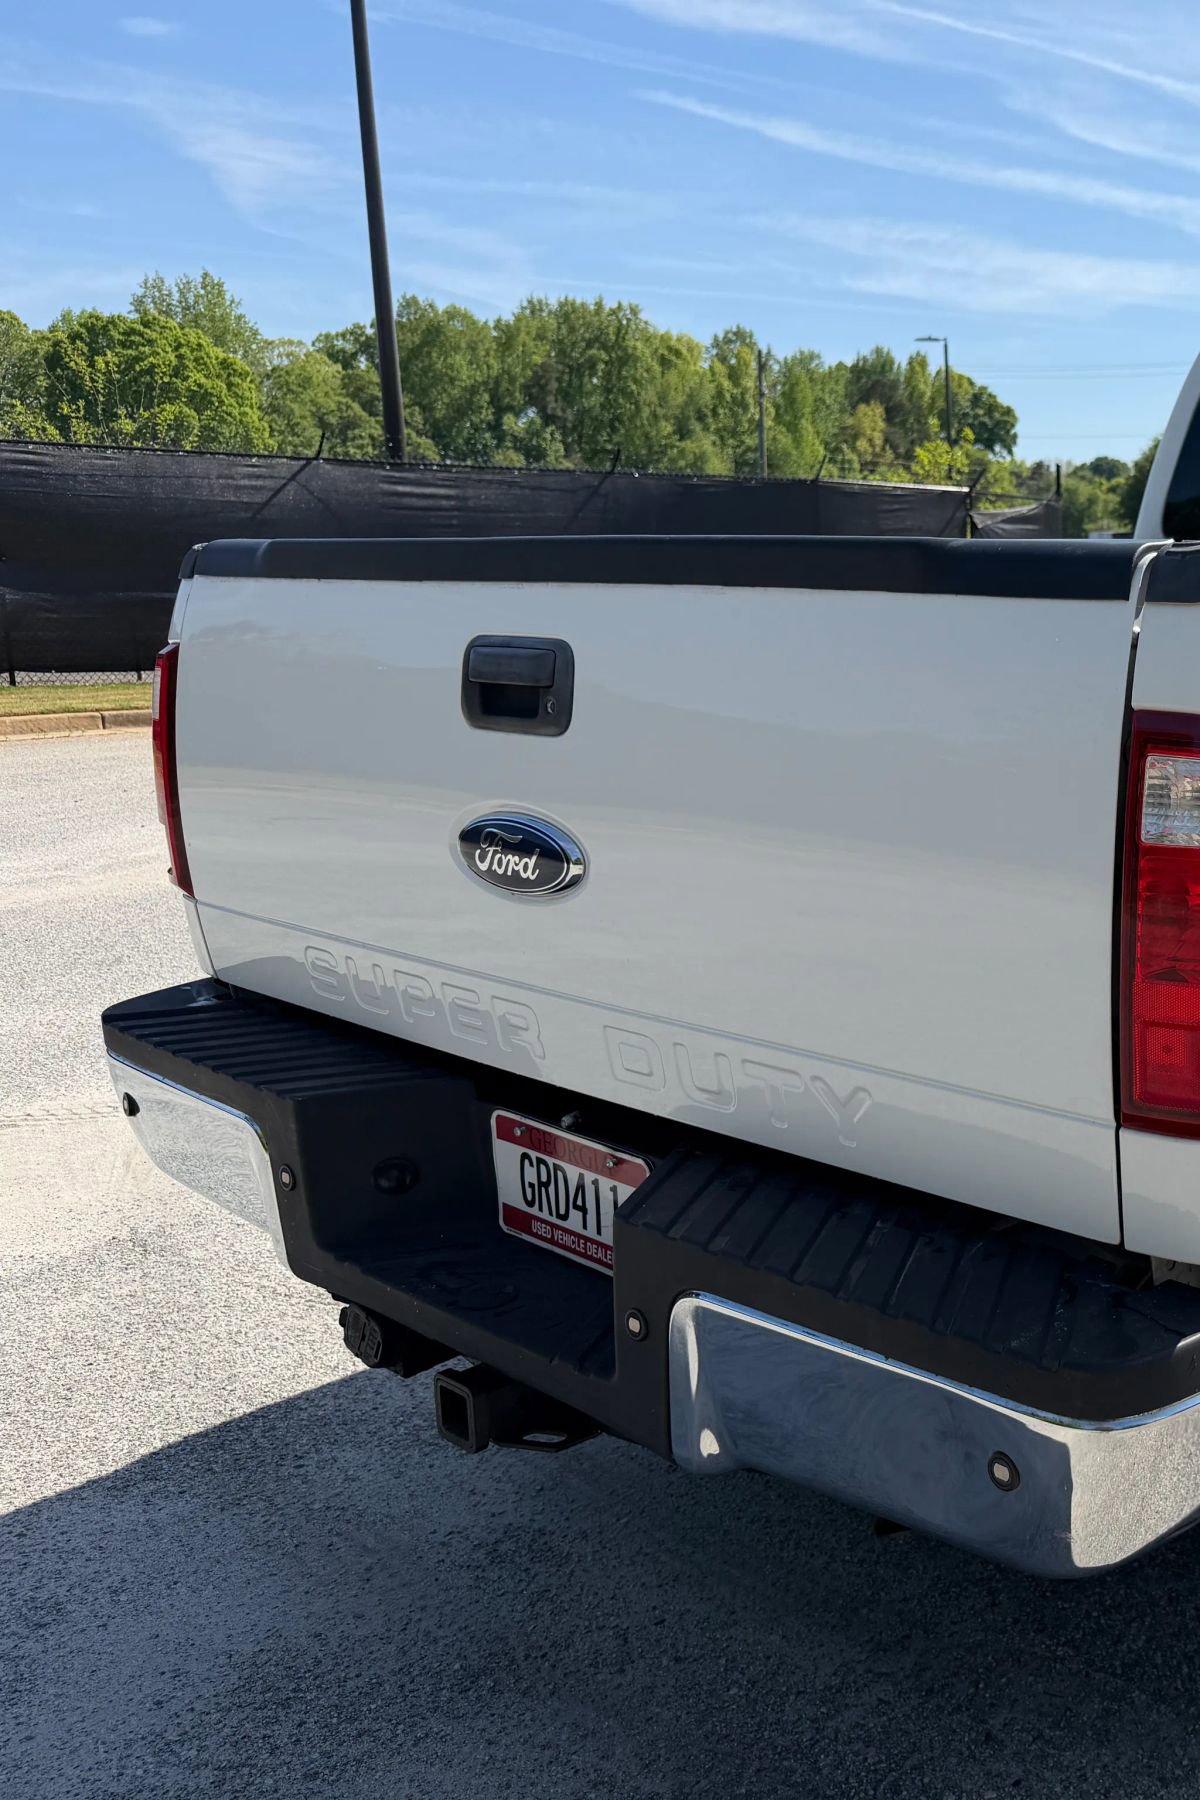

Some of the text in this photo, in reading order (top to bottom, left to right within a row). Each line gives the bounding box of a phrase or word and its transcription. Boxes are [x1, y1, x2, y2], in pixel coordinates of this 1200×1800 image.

[475, 828, 541, 880] Ford
[303, 945, 873, 1148] SUPER DUTY
[531, 1219, 613, 1264] USED VEHICLE DEALE
